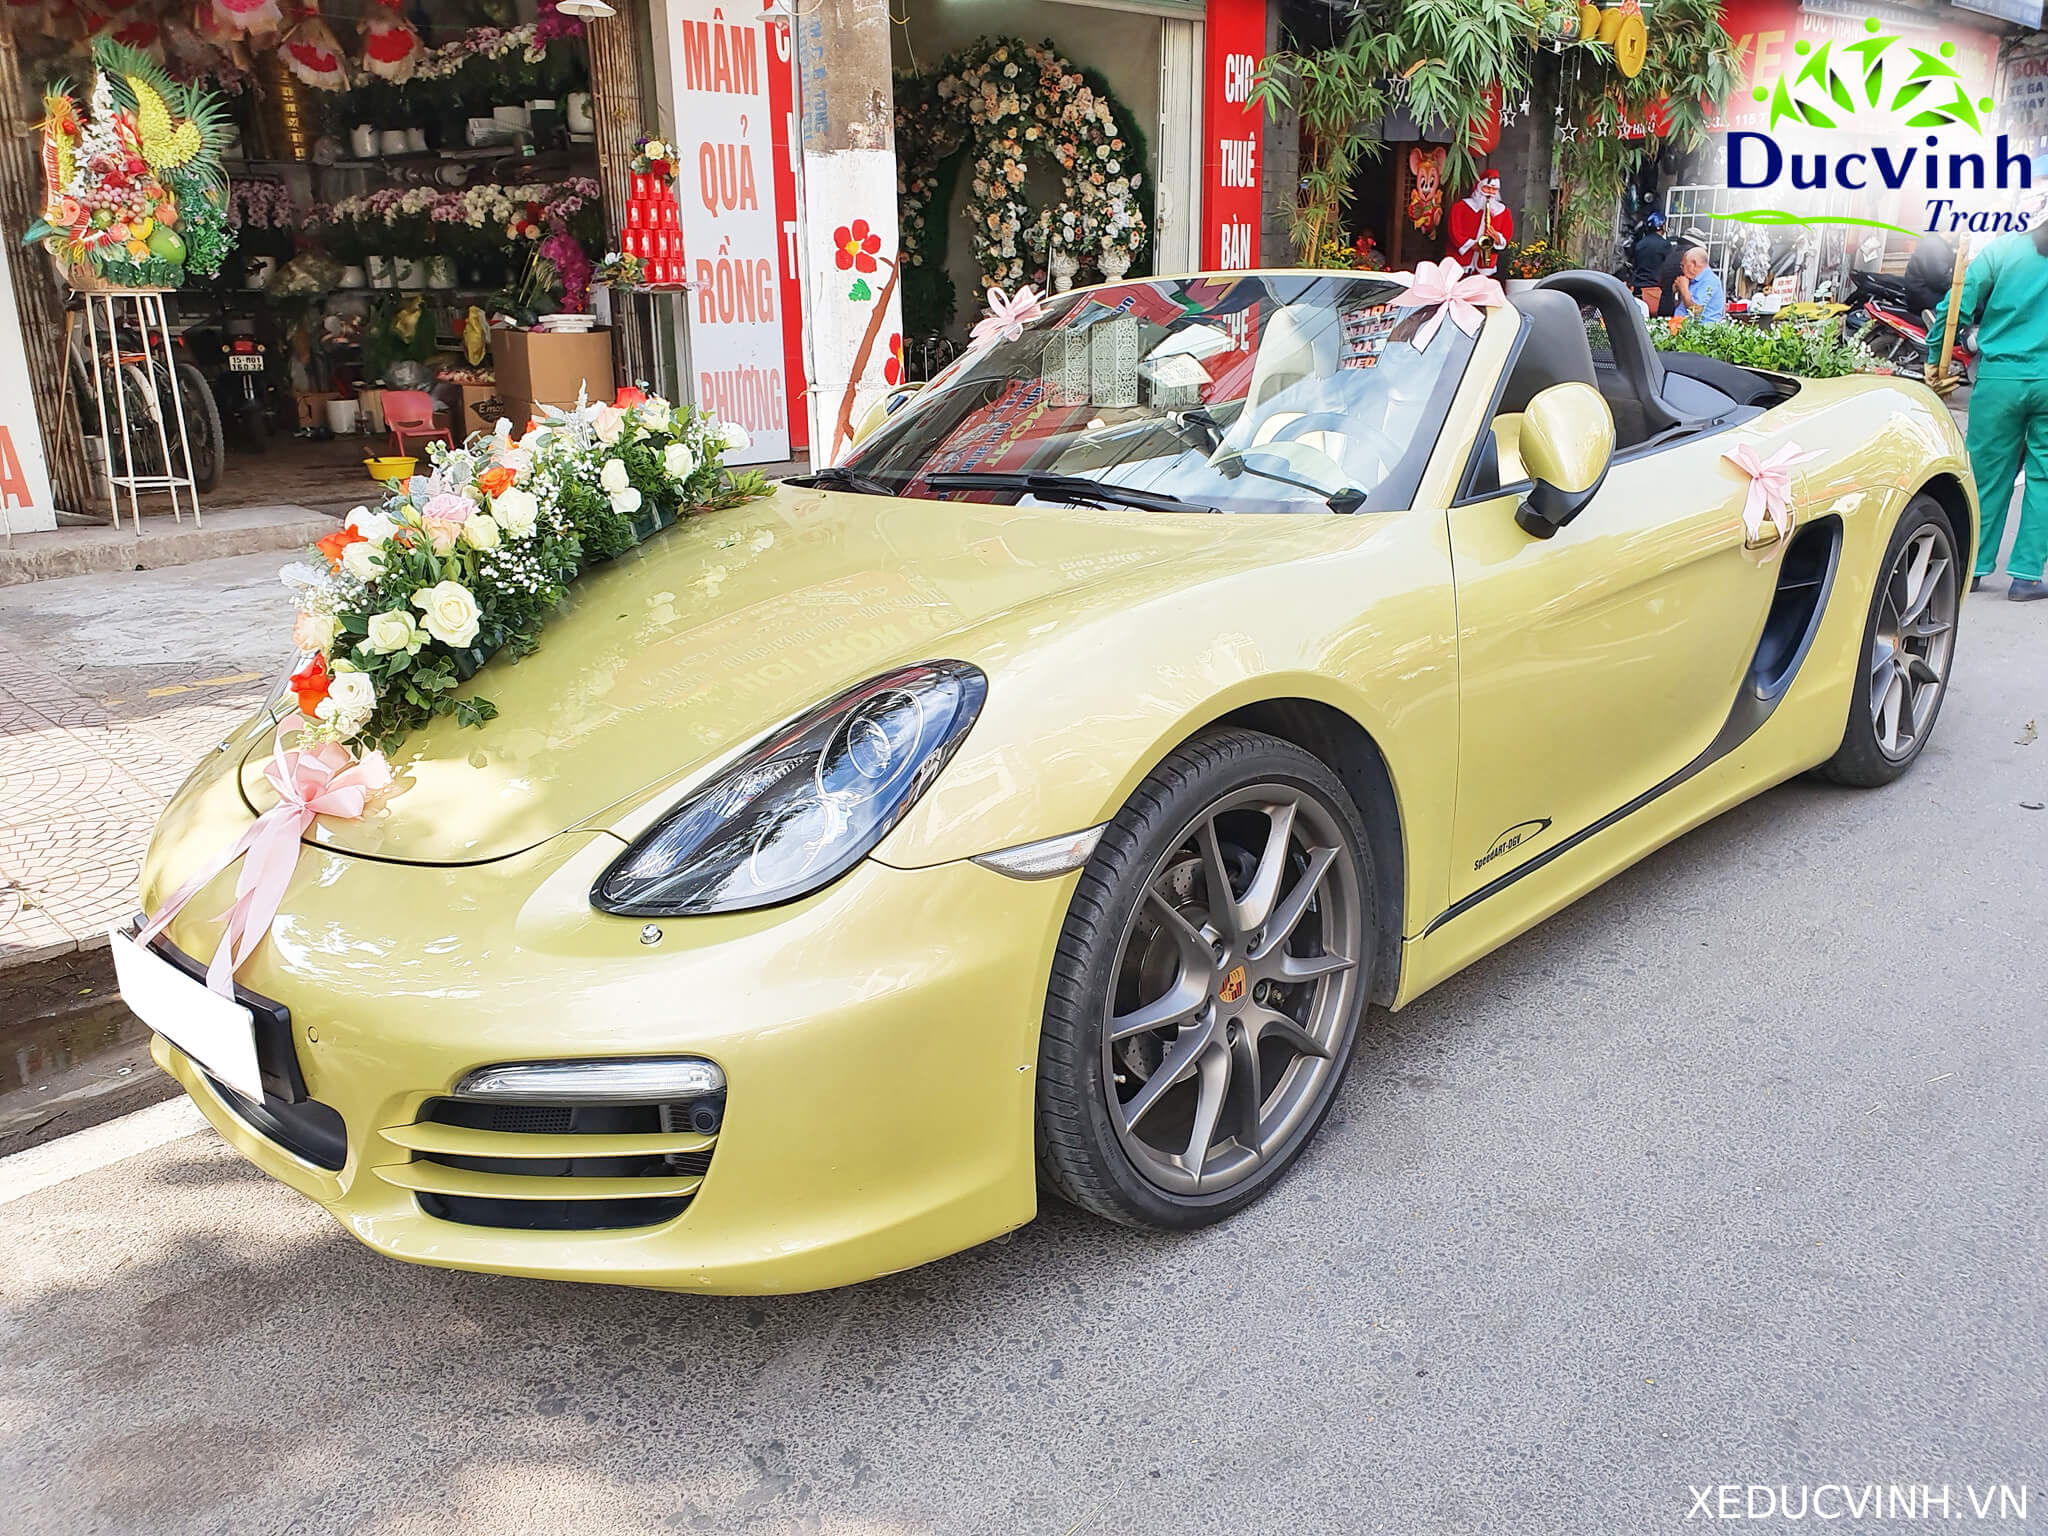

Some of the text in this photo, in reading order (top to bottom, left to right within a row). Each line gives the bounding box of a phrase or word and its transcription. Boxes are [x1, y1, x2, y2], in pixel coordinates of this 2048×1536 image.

[682, 8, 758, 95] MÂM
[1225, 54, 1254, 103] CHO
[699, 114, 758, 218] QUẢ
[1220, 132, 1256, 188] THUÊ
[696, 235, 774, 324] RỒNG
[1221, 213, 1251, 269] BÀN
[701, 364, 784, 447] PHƯỢNG
